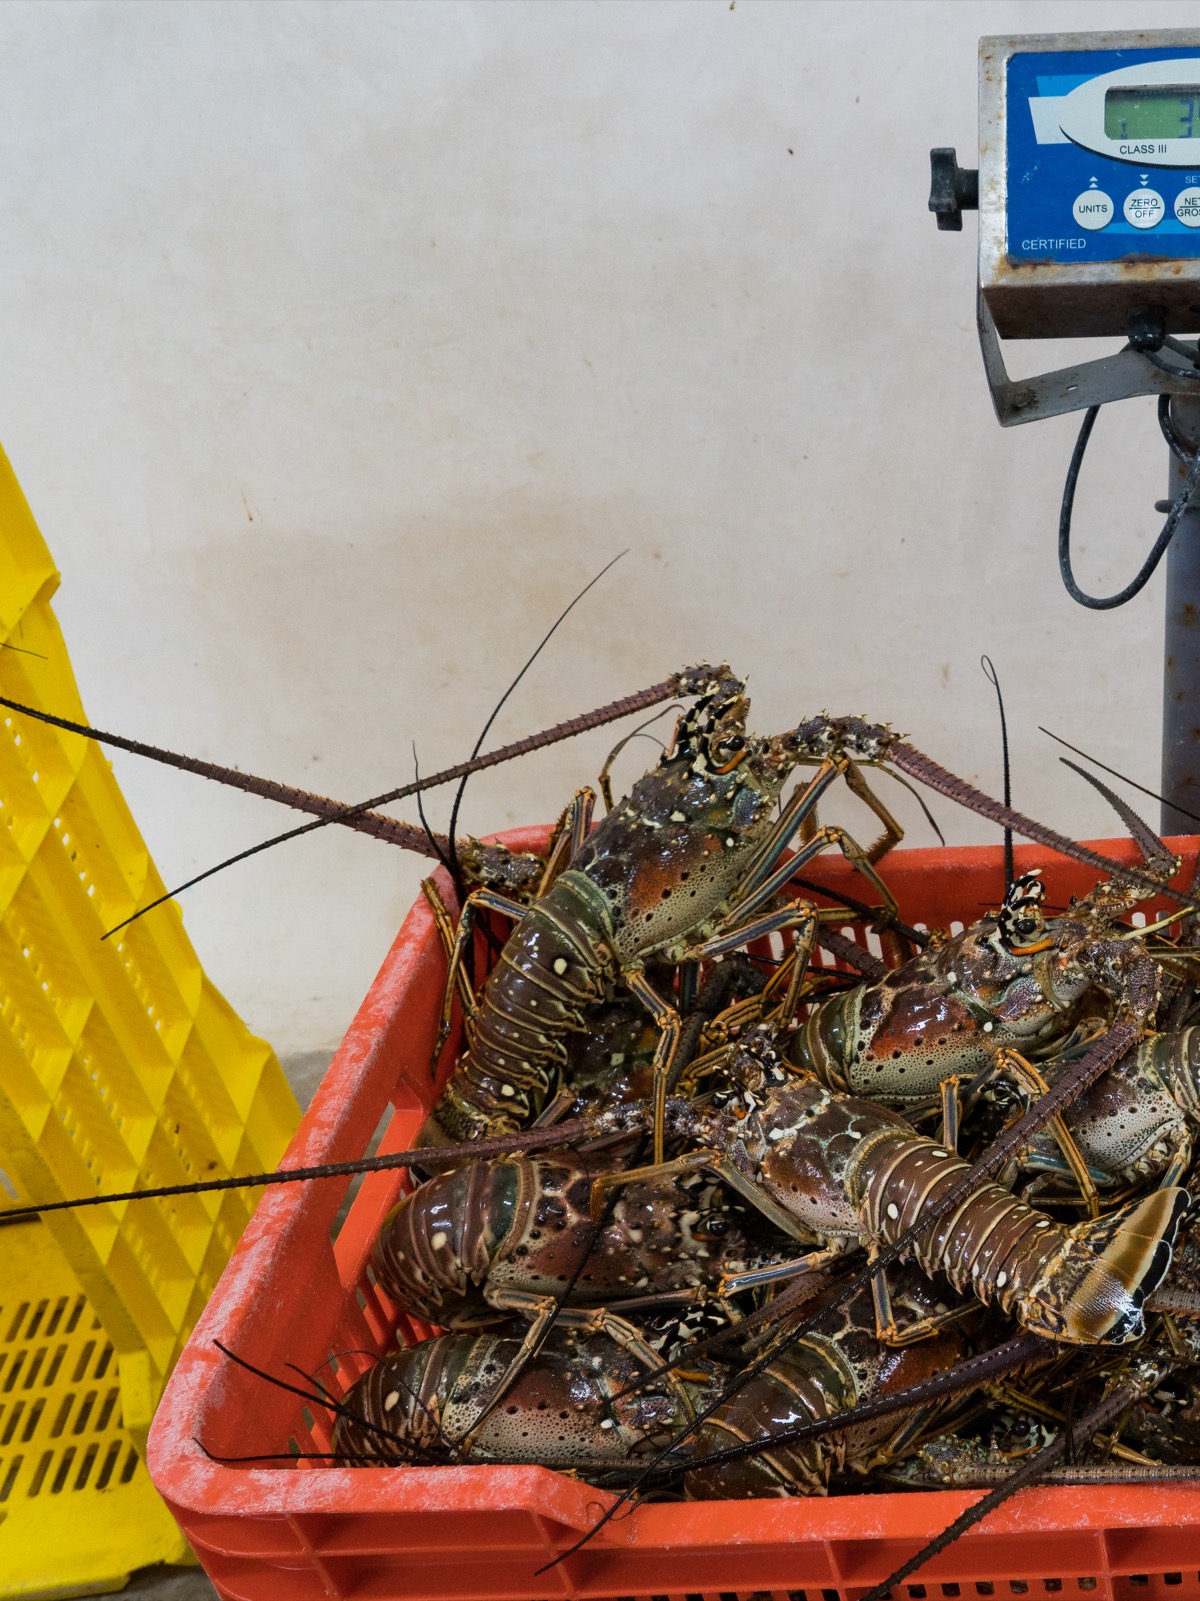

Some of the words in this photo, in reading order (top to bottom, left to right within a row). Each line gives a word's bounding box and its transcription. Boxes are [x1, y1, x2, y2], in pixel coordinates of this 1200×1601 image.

[1119, 145, 1155, 154] CLASS
[1158, 144, 1167, 153] III
[1131, 198, 1158, 207] ZERO
[1078, 204, 1108, 213] UNITS
[1135, 210, 1155, 218] OFF
[1021, 238, 1087, 250] CERTIFIED
